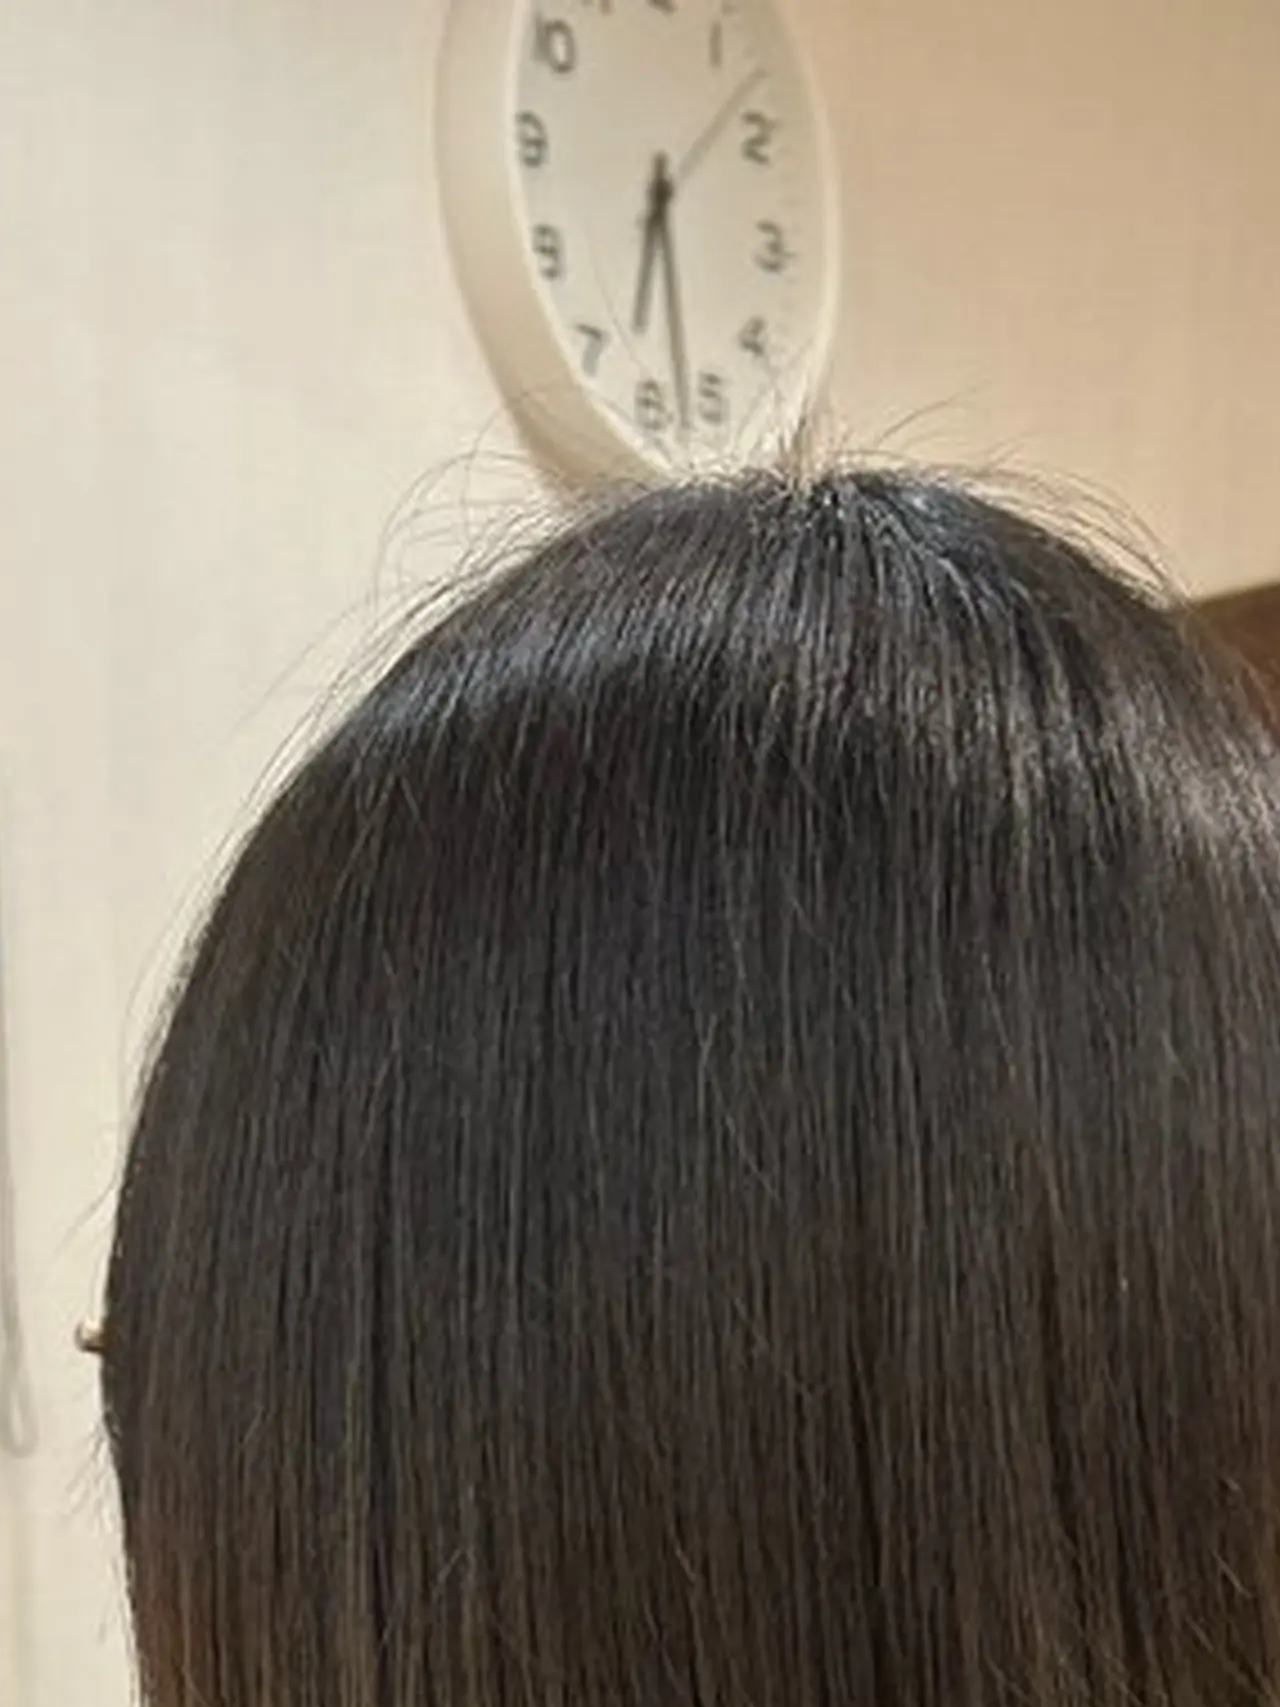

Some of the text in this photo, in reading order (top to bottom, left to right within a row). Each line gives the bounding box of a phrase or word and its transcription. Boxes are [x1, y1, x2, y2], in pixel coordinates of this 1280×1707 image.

[740, 111, 777, 164] 2
[756, 220, 796, 274] 3
[573, 324, 608, 377] 7
